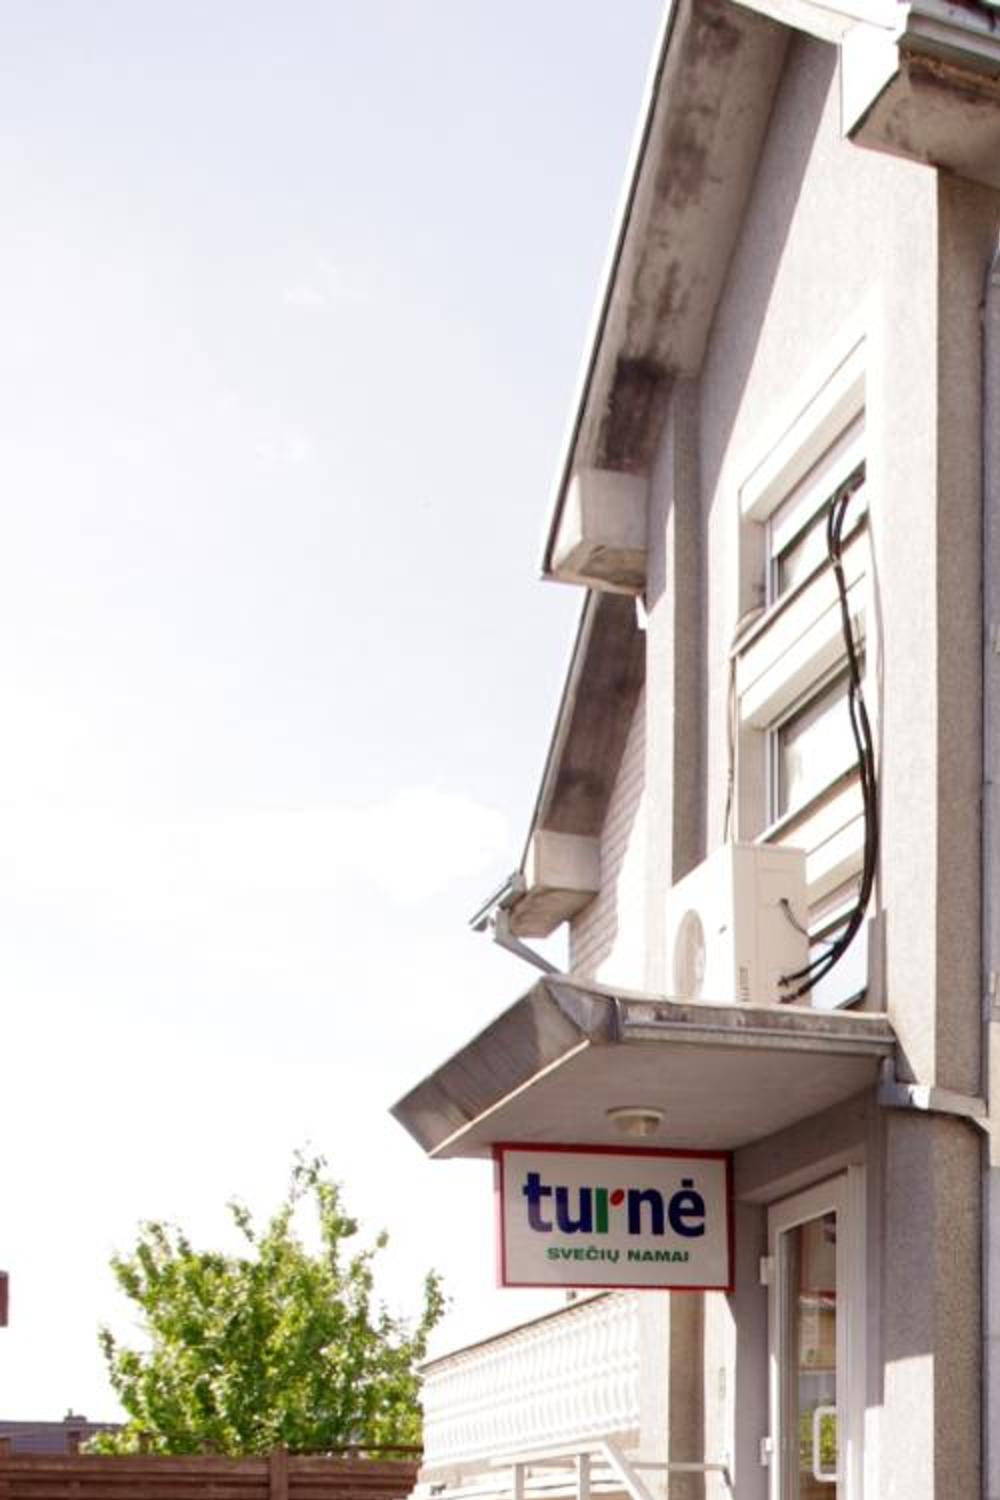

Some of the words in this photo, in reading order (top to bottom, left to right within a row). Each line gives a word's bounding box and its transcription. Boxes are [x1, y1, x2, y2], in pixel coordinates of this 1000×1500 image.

[523, 1172, 706, 1238] turnė
[547, 1246, 620, 1263] SVEČIŲ
[627, 1248, 690, 1262] NAMAI
